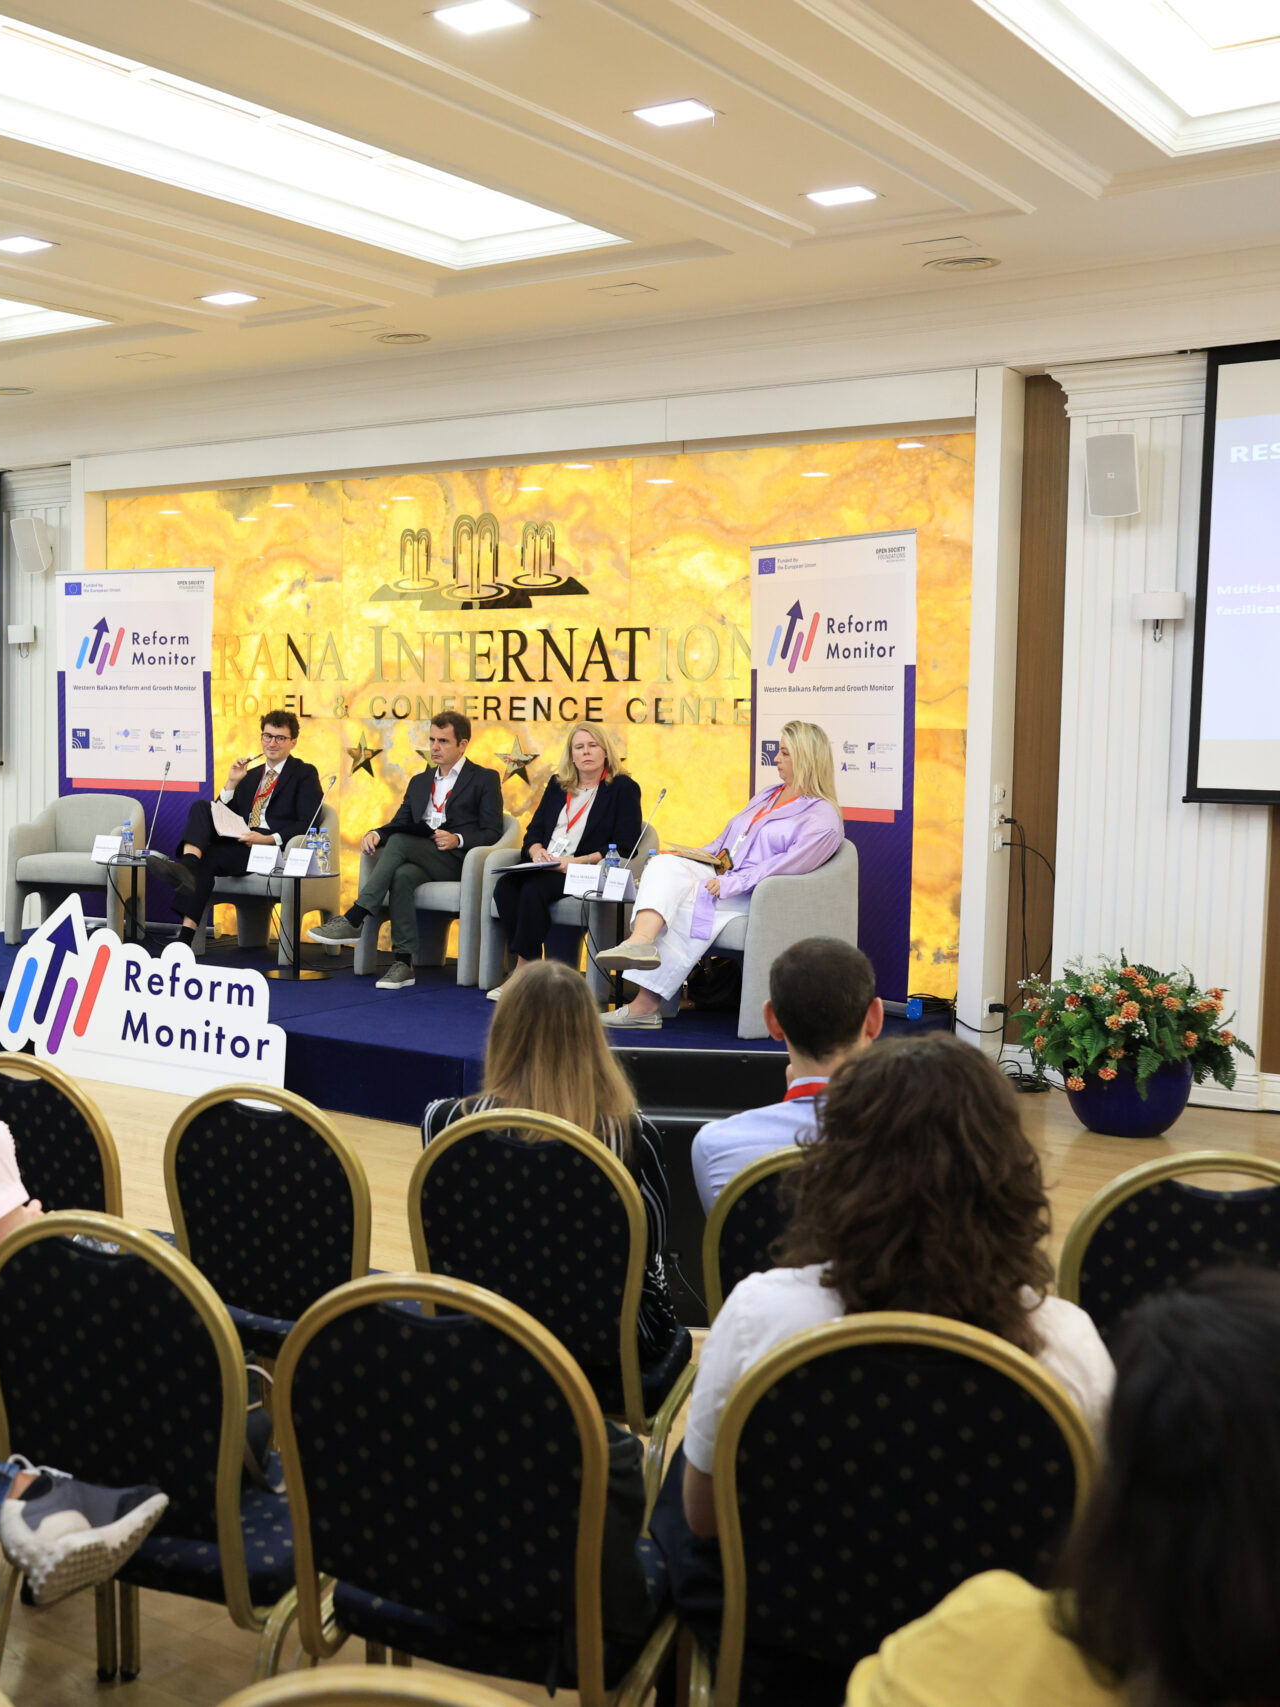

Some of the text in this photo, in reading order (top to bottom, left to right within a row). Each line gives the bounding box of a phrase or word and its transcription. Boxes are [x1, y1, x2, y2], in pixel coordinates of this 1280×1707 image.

[827, 615, 888, 634] Reform
[132, 630, 190, 646] Reform
[131, 651, 197, 665] Monitor
[211, 624, 751, 683] RANA INTERNATION
[826, 641, 896, 660] Monitor
[73, 684, 96, 692] Western
[97, 684, 119, 692] Balkans
[120, 684, 140, 692] Reform
[152, 684, 173, 692] Growth
[174, 684, 197, 692] Monitor
[764, 685, 787, 693] Western
[789, 685, 811, 693] Balkans
[846, 684, 868, 692] Growth
[870, 683, 895, 691] Monitor
[221, 694, 751, 724] HOTEL & CONFERENCE CENTE
[124, 959, 255, 1008] Reform
[120, 1009, 271, 1062] Monitor
